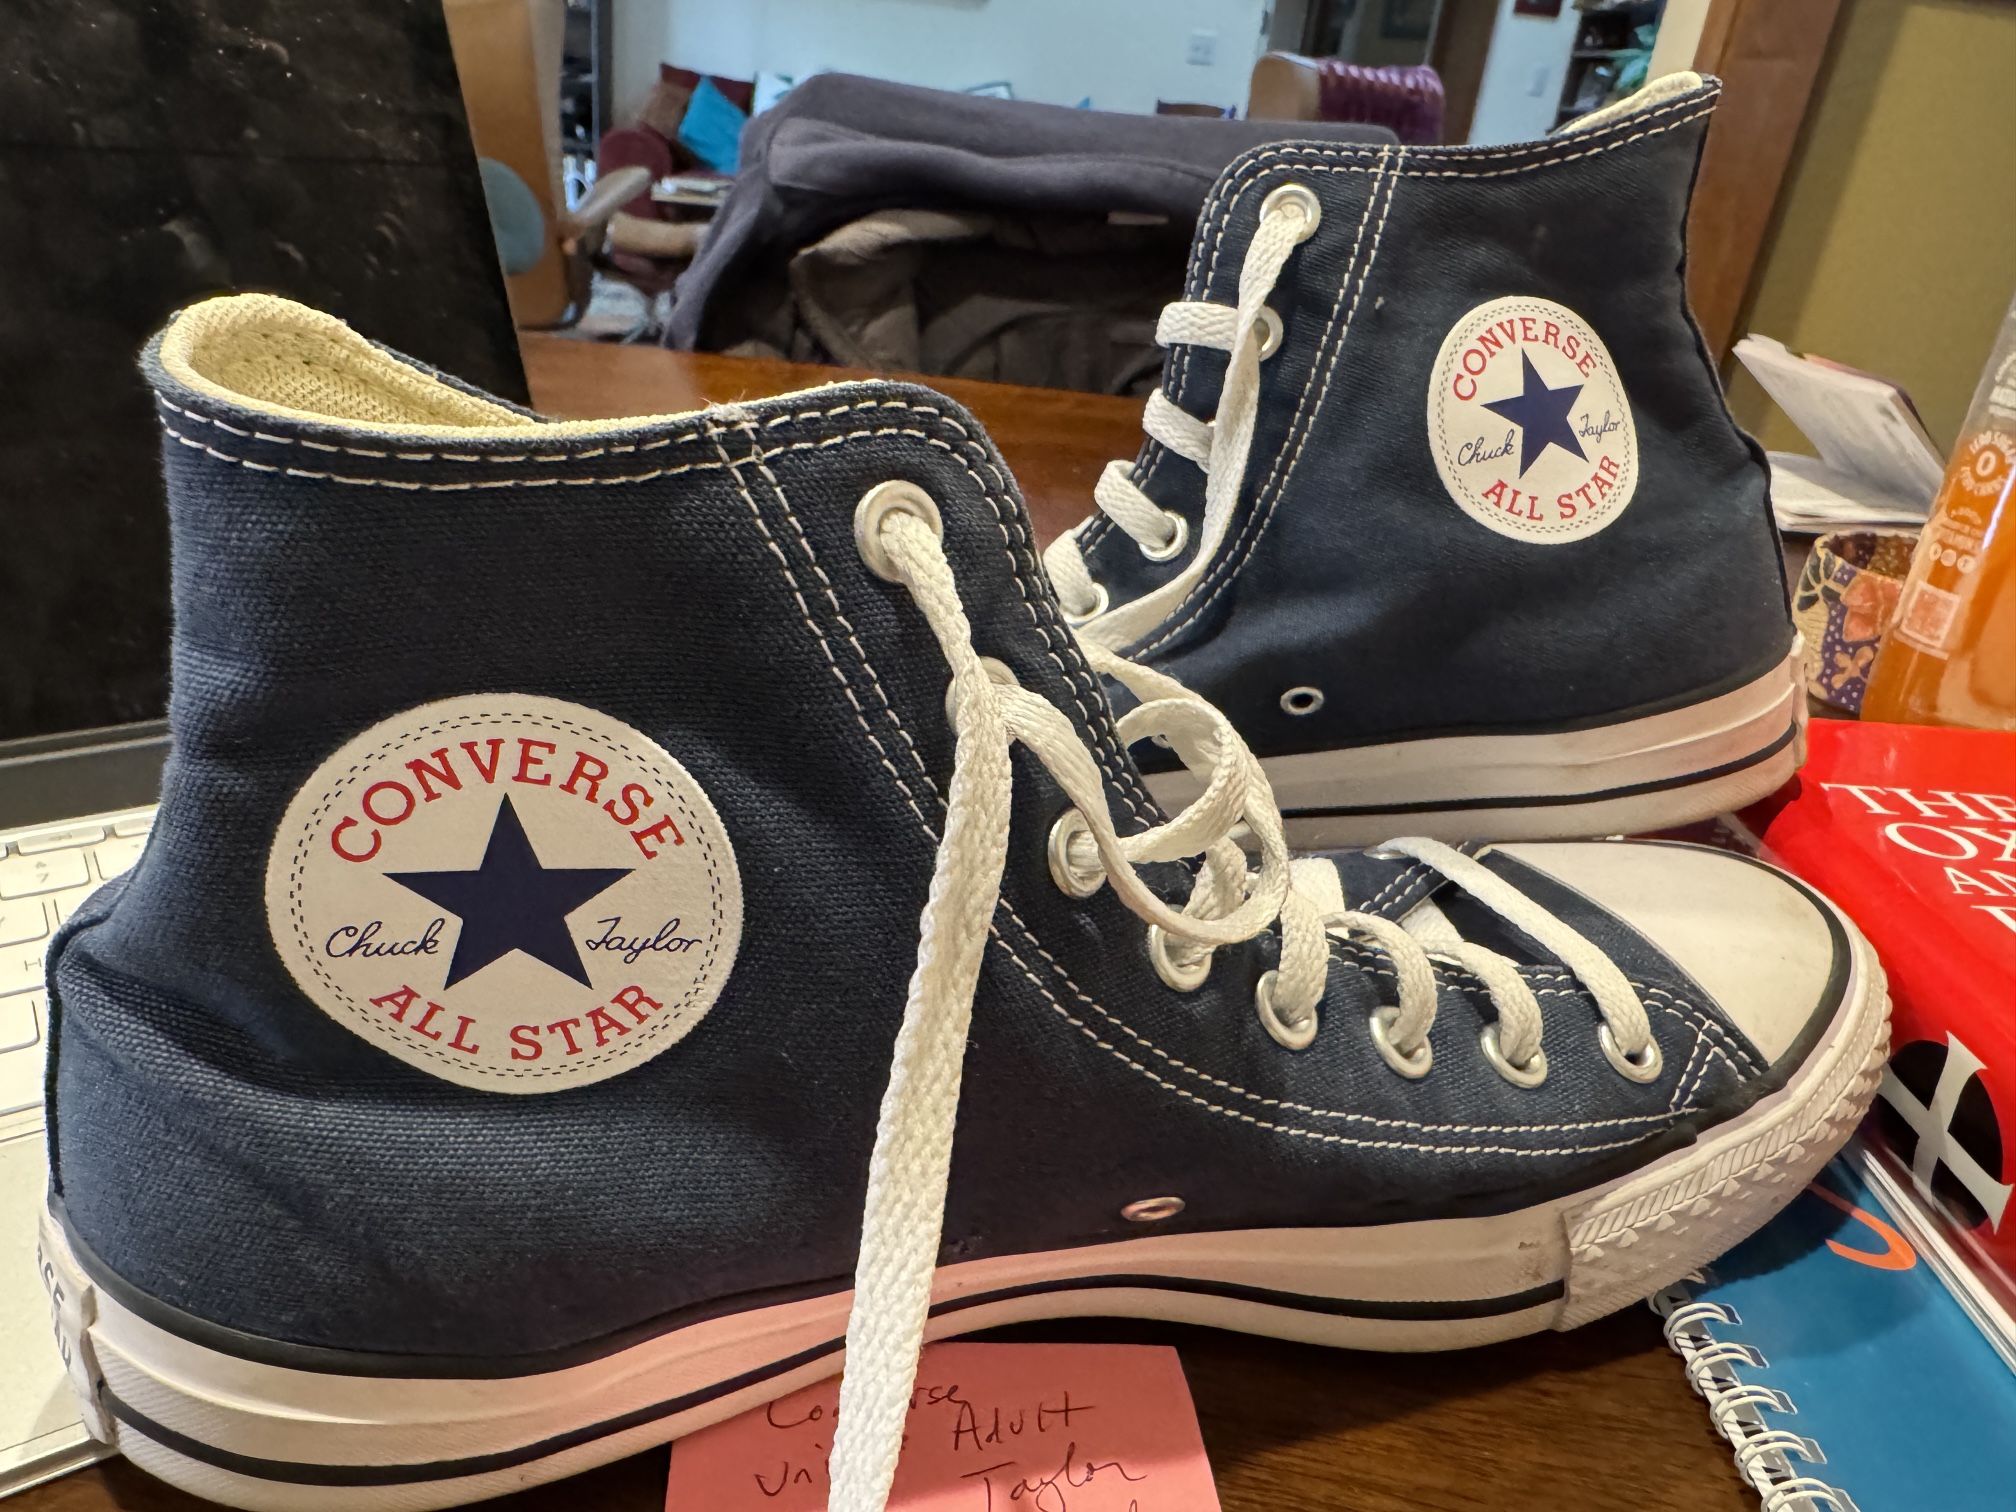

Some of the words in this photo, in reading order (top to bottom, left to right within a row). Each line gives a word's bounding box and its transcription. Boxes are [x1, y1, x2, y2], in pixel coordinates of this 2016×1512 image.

[1453, 317, 1597, 401] CONVERSE
[1457, 428, 1515, 467] Chuck
[1578, 410, 1621, 444] Taylor
[1482, 479, 1544, 522] ALL
[1556, 454, 1621, 520] STAR
[331, 737, 685, 863] CONVERSE
[325, 917, 446, 958] Chuck
[585, 916, 703, 964] Taylor
[370, 984, 480, 1055] ALL
[510, 984, 664, 1061] STAR
